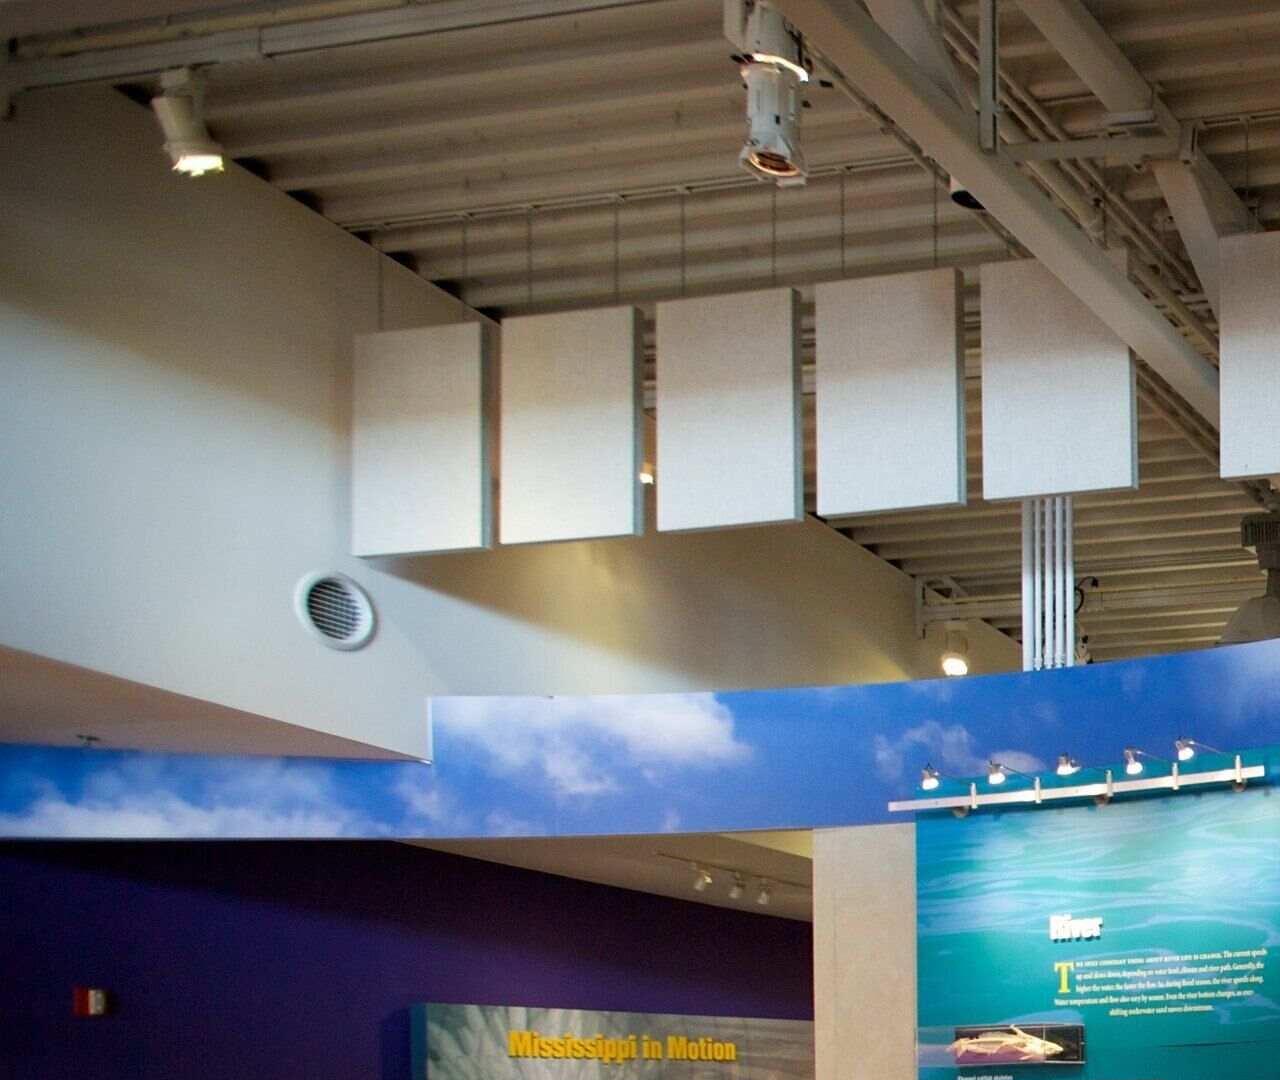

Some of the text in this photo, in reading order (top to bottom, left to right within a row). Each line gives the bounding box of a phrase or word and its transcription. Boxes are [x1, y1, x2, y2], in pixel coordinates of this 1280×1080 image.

[1050, 913, 1102, 940] River
[508, 1030, 736, 1064] Mississippi in Motion
